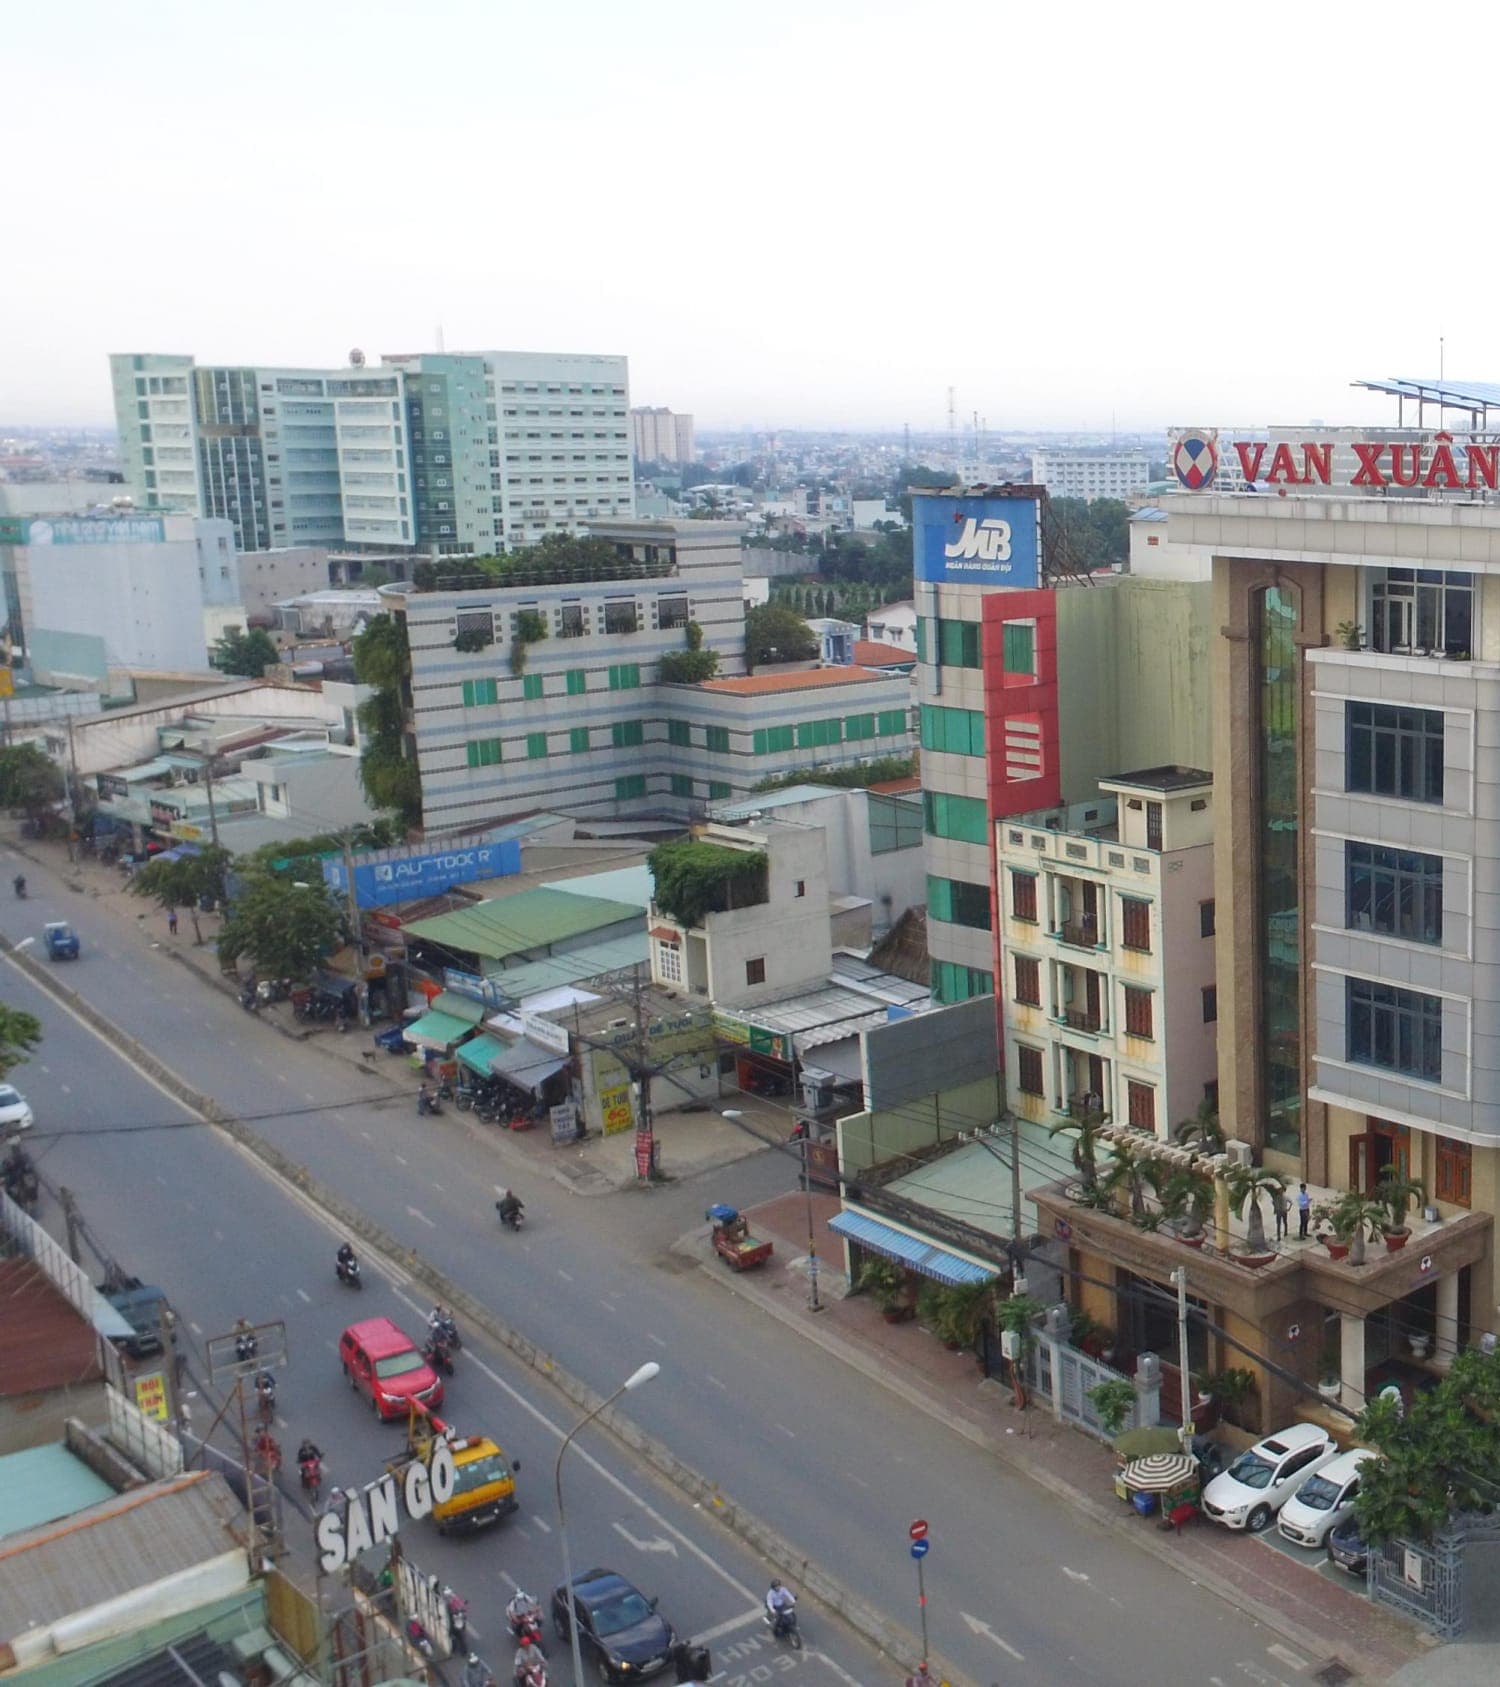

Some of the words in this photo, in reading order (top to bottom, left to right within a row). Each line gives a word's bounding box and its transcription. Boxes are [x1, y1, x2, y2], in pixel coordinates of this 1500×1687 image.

[1233, 442, 1335, 498] VẠN
[945, 518, 1012, 560] MB
[318, 1477, 399, 1573] SÀN
[404, 1425, 456, 1520] GỖ
